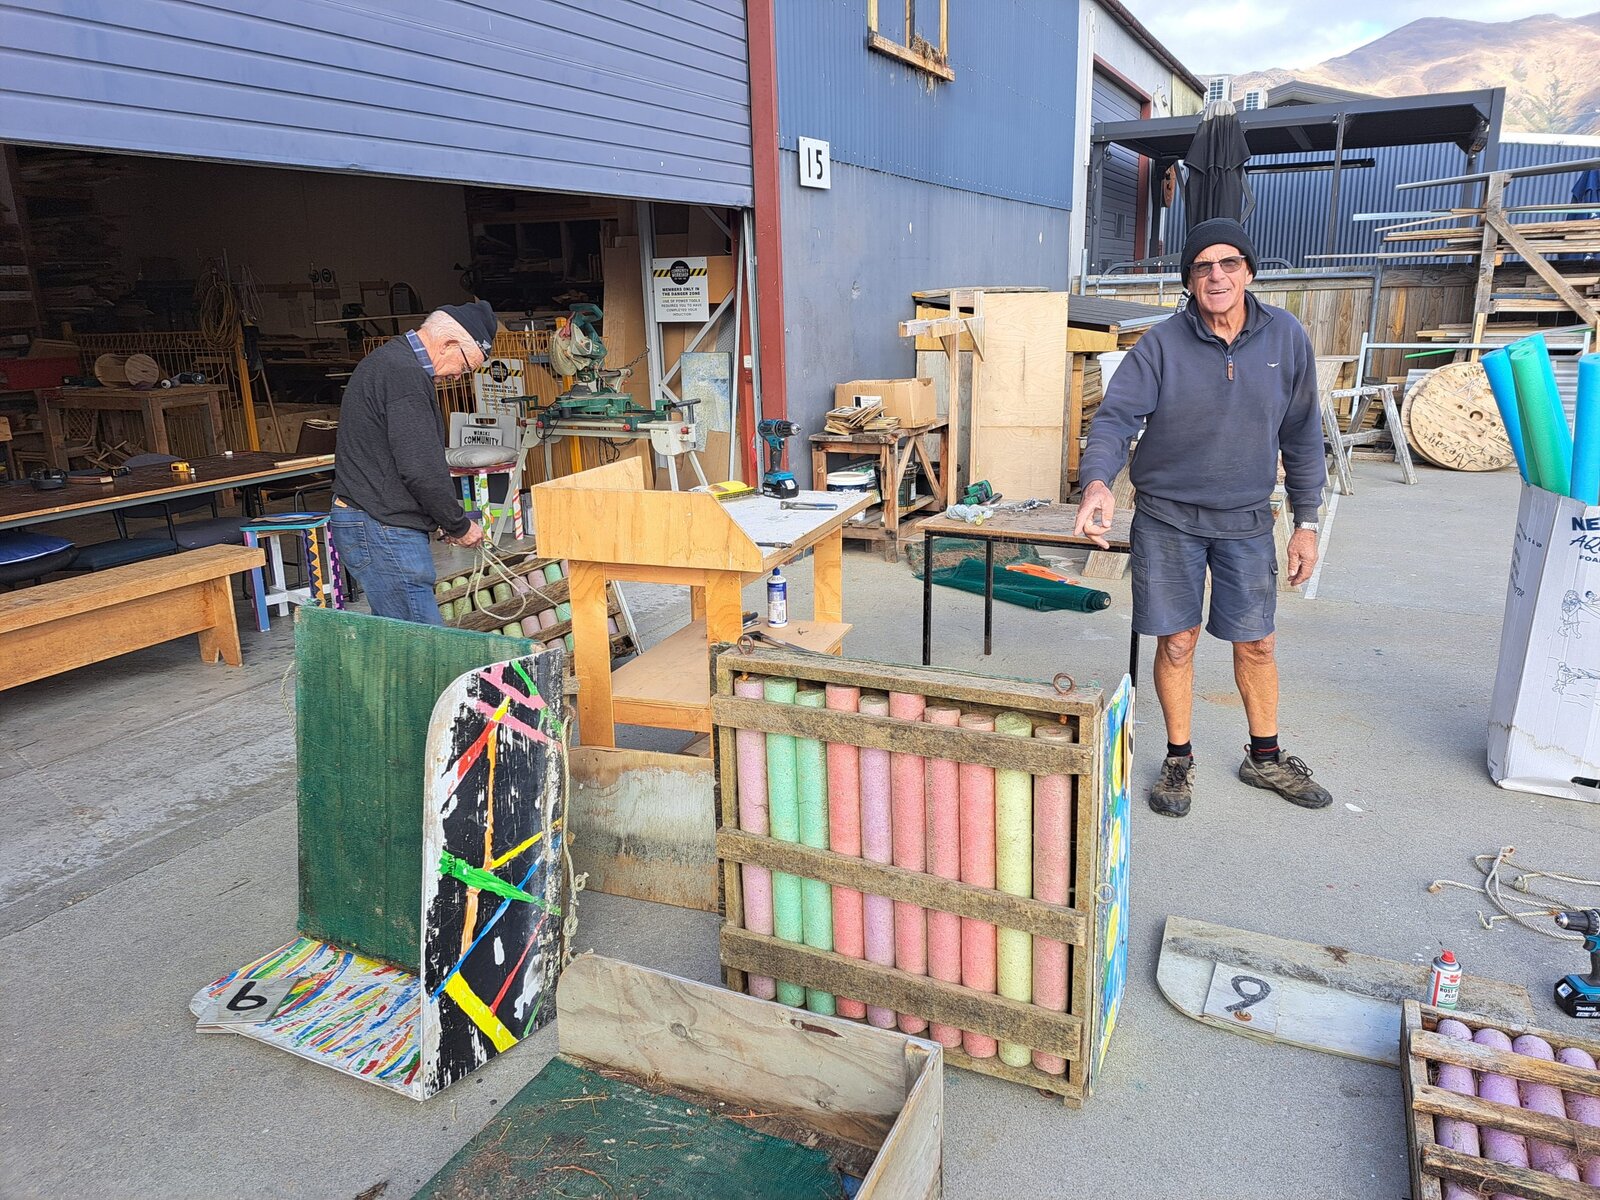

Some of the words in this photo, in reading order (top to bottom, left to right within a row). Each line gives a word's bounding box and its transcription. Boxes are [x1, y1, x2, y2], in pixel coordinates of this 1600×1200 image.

[808, 147, 823, 180] 15
[464, 435, 499, 446] COMMUNITY
[1571, 517, 1600, 531] NE
[1569, 535, 1600, 554] AQ
[1579, 554, 1600, 563] FOA
[226, 981, 268, 1011] 6
[1224, 975, 1272, 1013] 9
